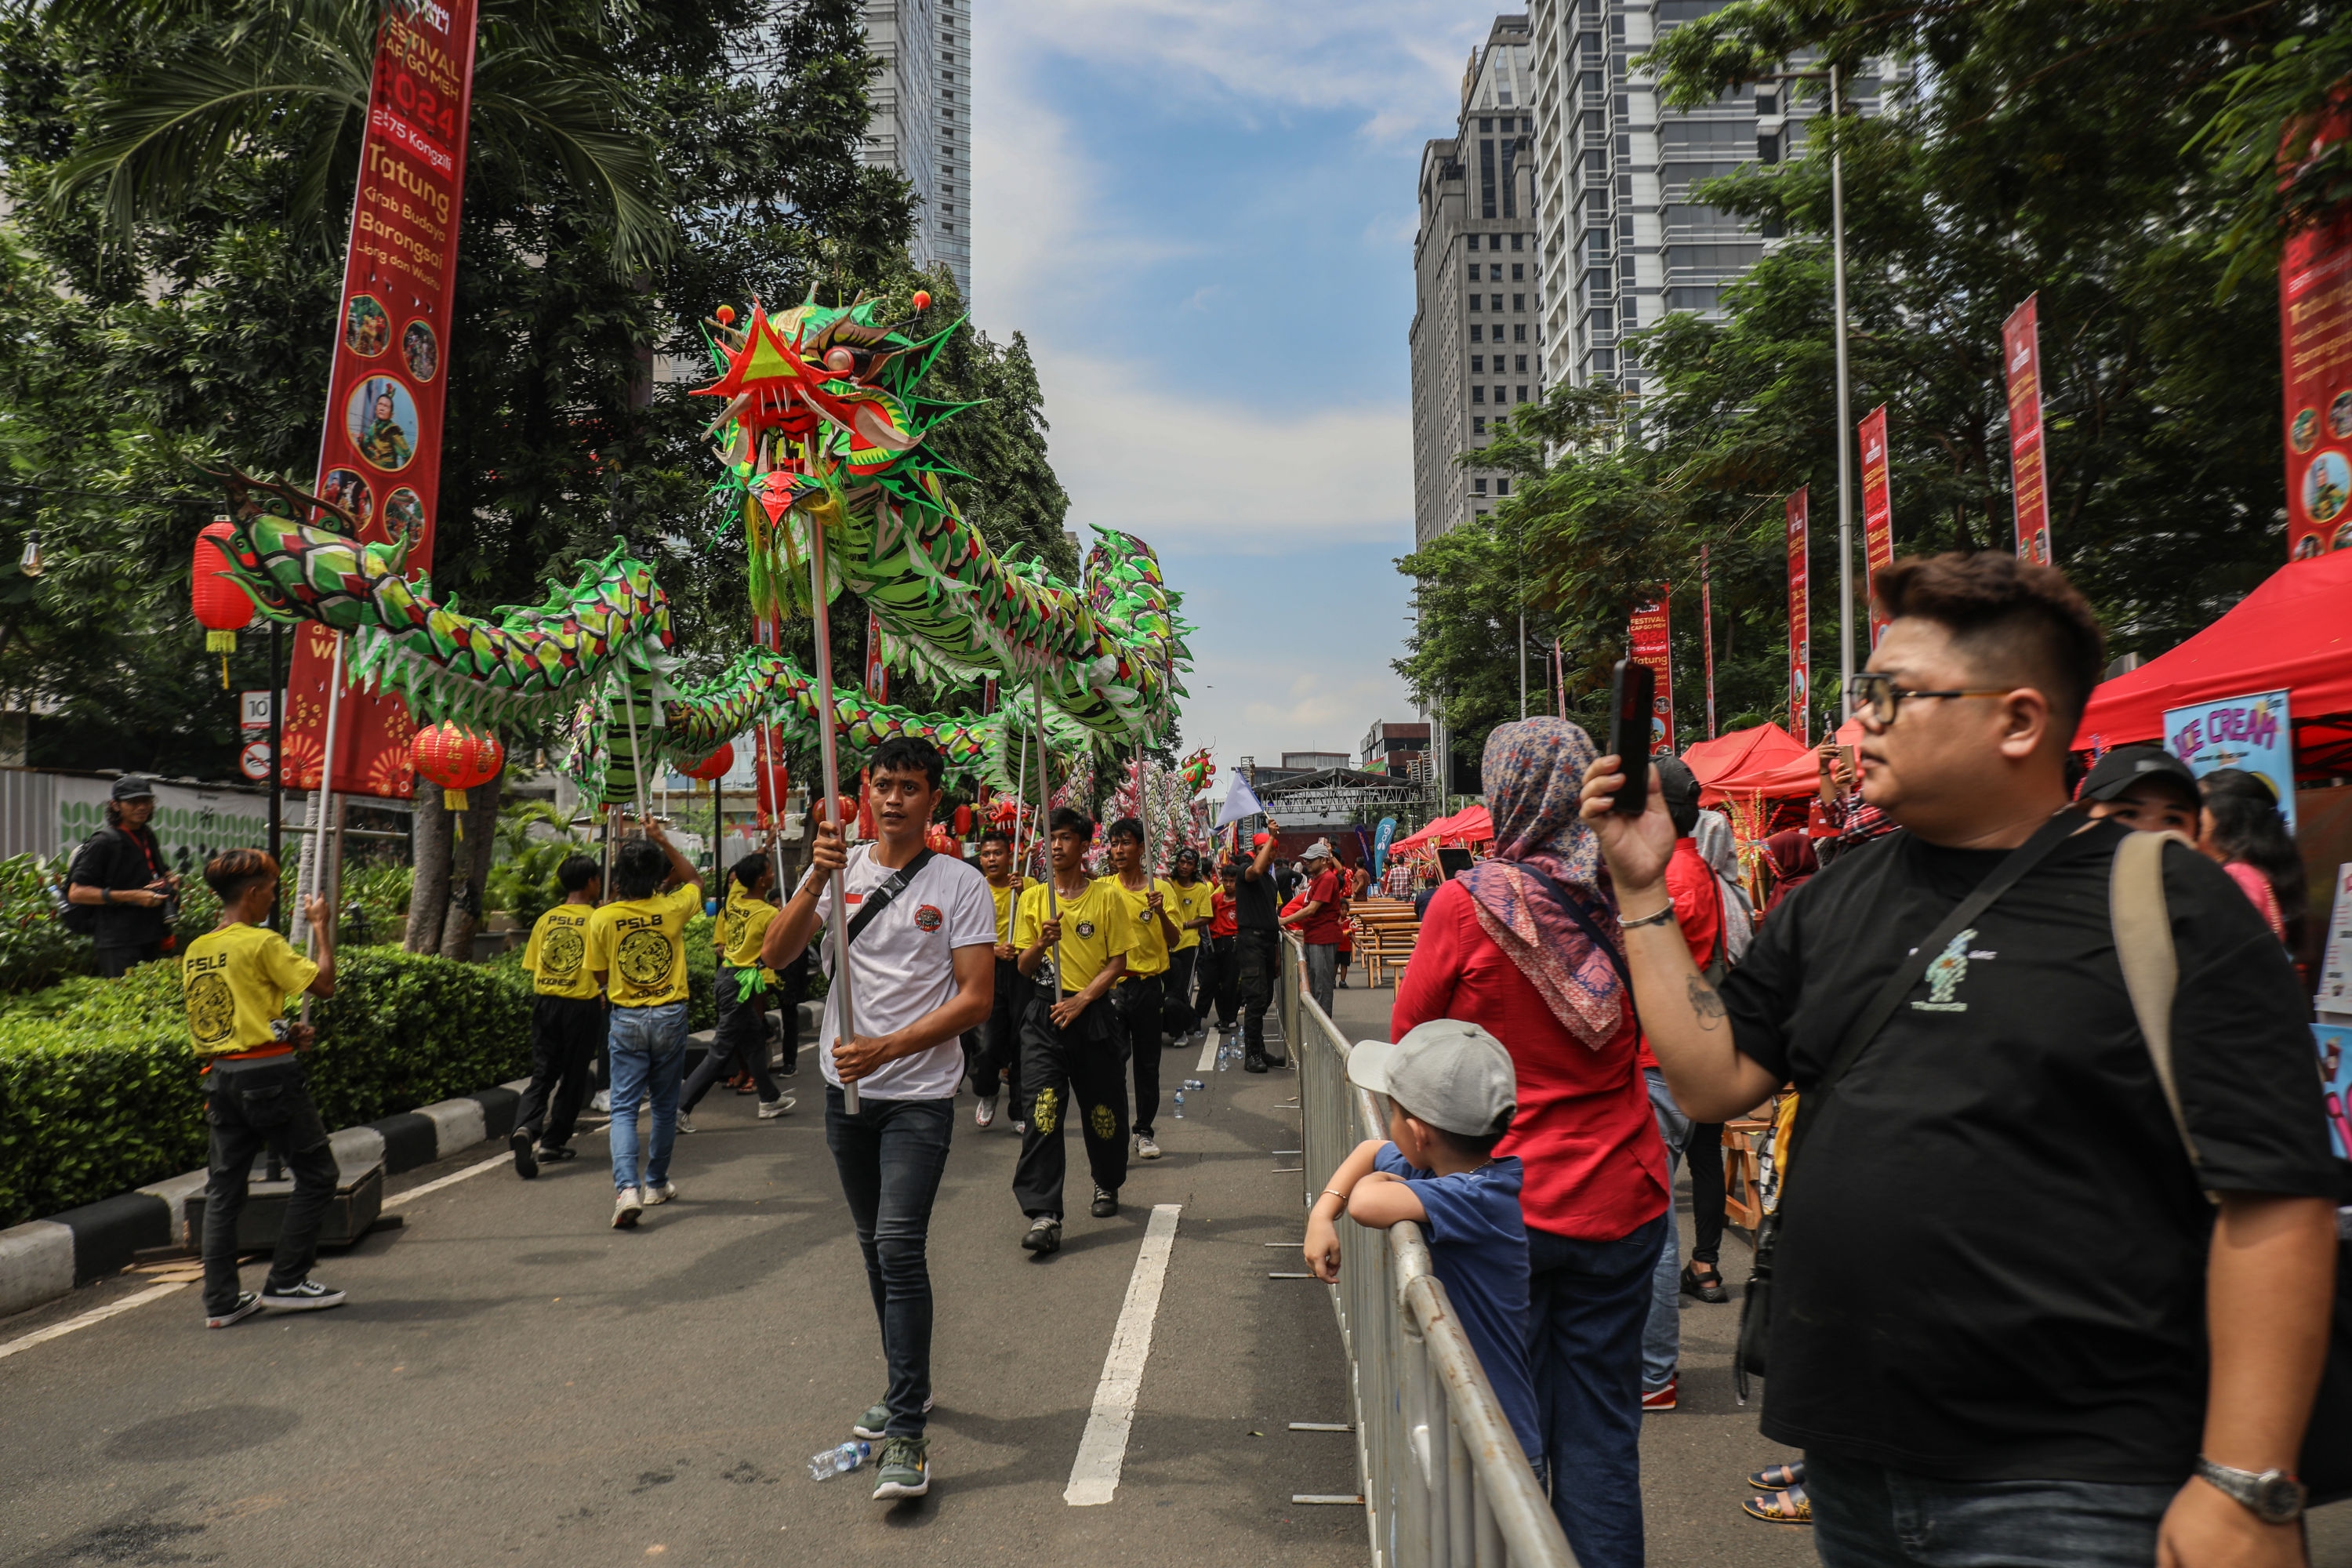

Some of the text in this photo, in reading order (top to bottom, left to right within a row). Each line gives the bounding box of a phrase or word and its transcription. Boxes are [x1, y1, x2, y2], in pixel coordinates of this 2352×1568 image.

[390, 14, 460, 82] ESTIVAL
[407, 53, 427, 77] GO
[430, 69, 459, 102] MEH
[408, 129, 452, 171] Kongzili
[369, 143, 450, 224] Tatung
[359, 210, 444, 270] Barongsai
[401, 203, 446, 243] Budaya
[356, 238, 388, 265] Liong
[390, 254, 410, 273] dan
[1630, 615, 1666, 626] FESTIVAL
[1632, 655, 1668, 666] Tatung
[2172, 708, 2278, 761] ICE CREAM
[548, 915, 585, 927] PSLB
[615, 913, 663, 931] PSLB
